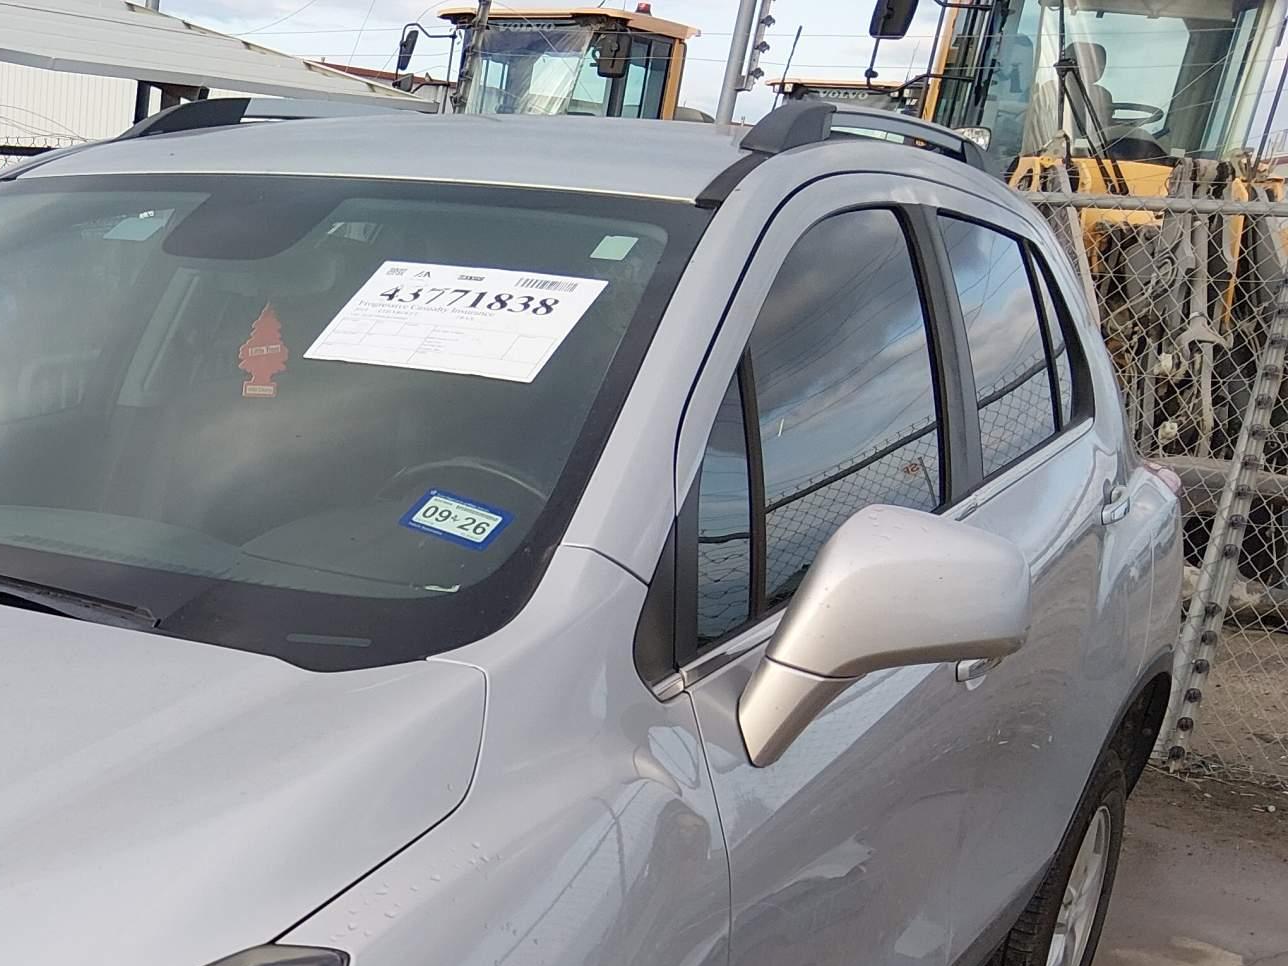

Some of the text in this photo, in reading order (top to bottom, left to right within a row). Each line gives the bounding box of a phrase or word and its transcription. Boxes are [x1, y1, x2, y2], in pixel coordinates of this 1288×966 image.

[819, 88, 869, 100] VOLVO
[379, 286, 560, 316] 43771838
[422, 505, 453, 523] 09
[456, 517, 491, 536] 26
